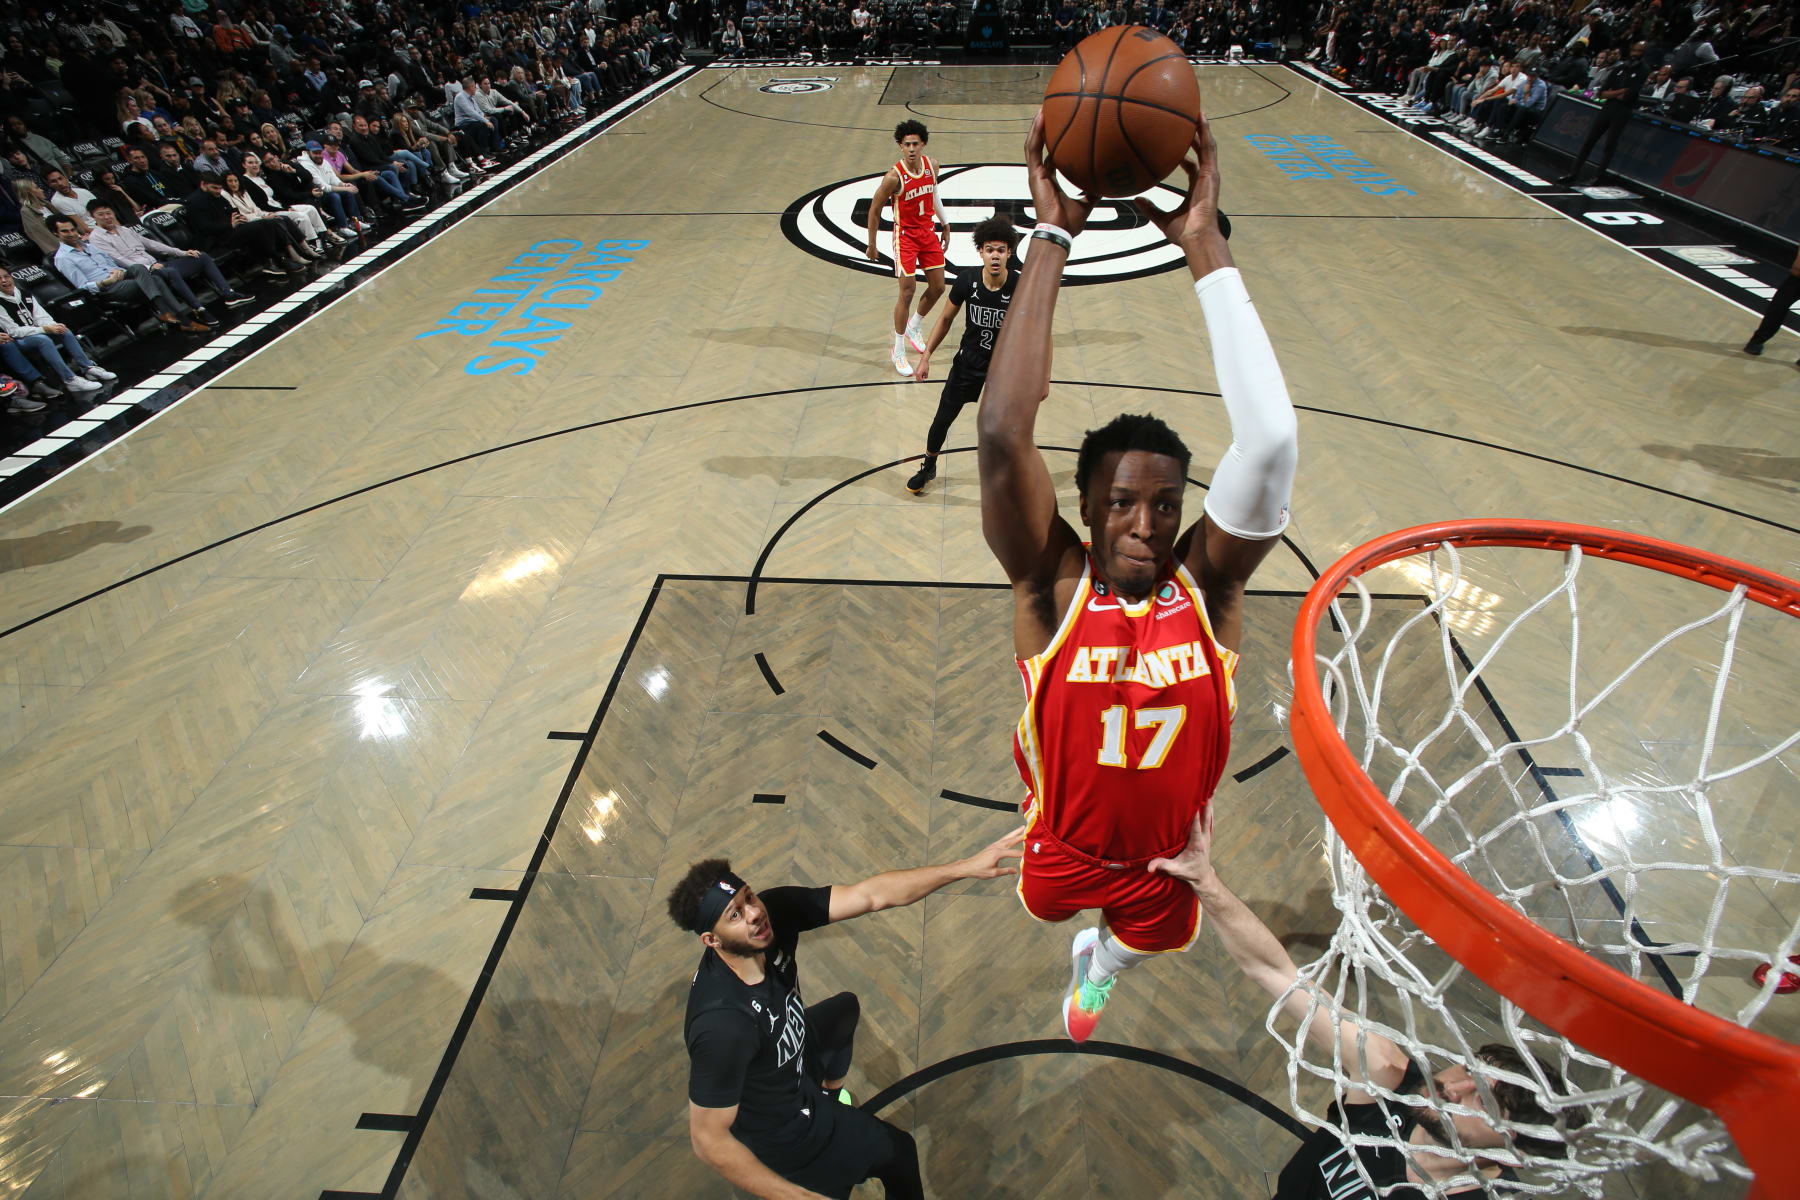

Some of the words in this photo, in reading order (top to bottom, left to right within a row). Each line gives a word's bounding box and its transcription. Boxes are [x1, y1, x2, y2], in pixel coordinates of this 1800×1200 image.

[1243, 133, 1335, 181] CENTER
[1289, 134, 1417, 196] BARCLAYS
[918, 200, 925, 216] 1
[11, 264, 43, 280] QATAR
[412, 238, 584, 341] CENTER
[463, 239, 652, 376] BARCLAYS
[979, 329, 994, 350] 2
[1155, 601, 1192, 621] sharecare
[1065, 640, 1211, 689] ATLANTA
[1097, 704, 1187, 770] 17
